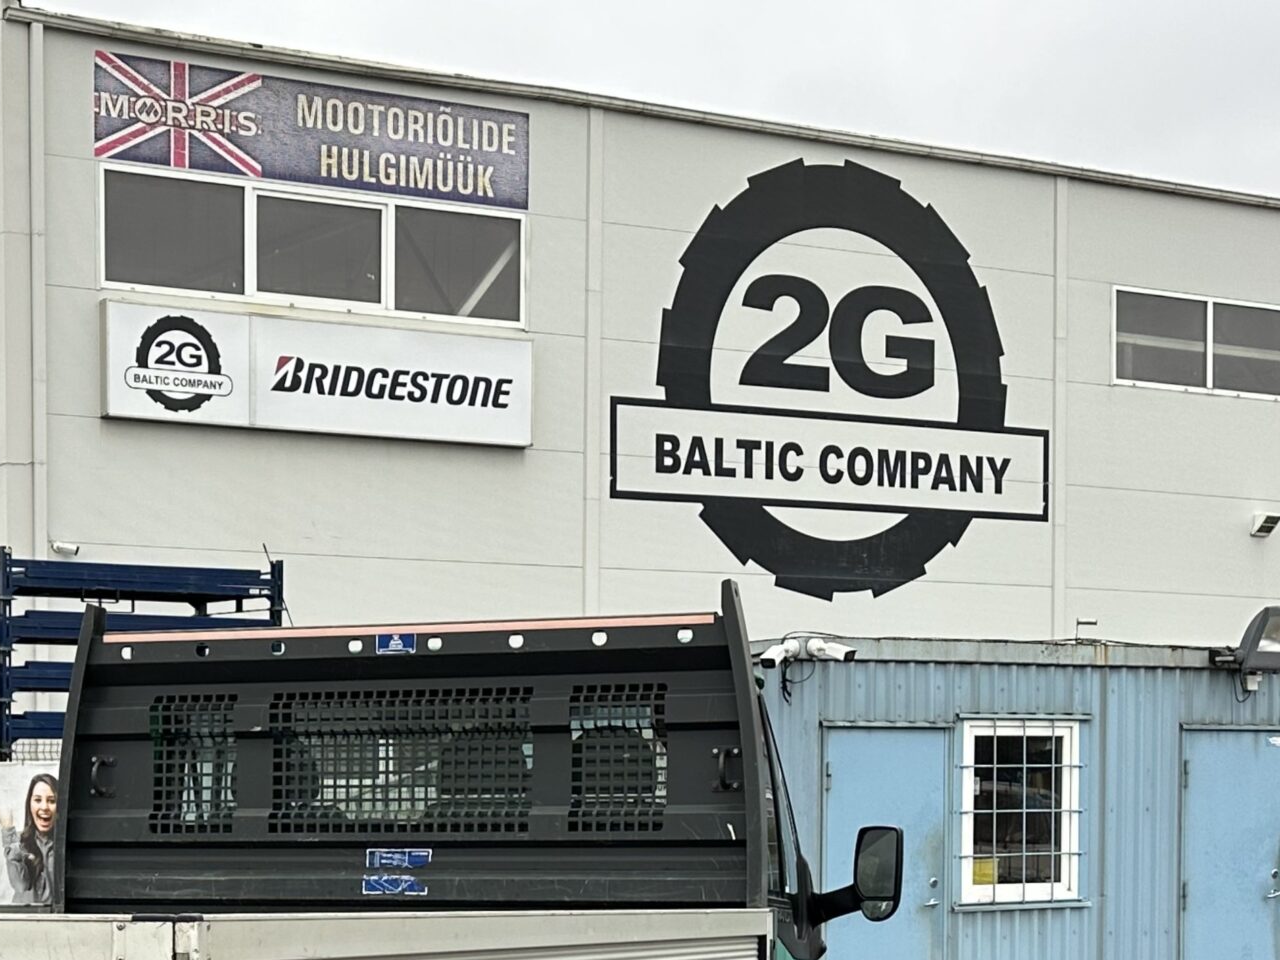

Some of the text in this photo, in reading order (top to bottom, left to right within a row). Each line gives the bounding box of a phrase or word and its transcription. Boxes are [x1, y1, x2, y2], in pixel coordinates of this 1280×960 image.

[99, 92, 259, 137] MORRIS
[297, 94, 517, 156] MOOTORIÕLIDE
[321, 145, 495, 198] HULGIMÜÜK
[154, 340, 203, 368] 2G
[739, 274, 936, 400] 2G
[133, 373, 224, 390] BALTIC COMPANY
[271, 356, 513, 409] BRIDGESTONE
[655, 433, 1012, 494] BALTIC COMPANY
